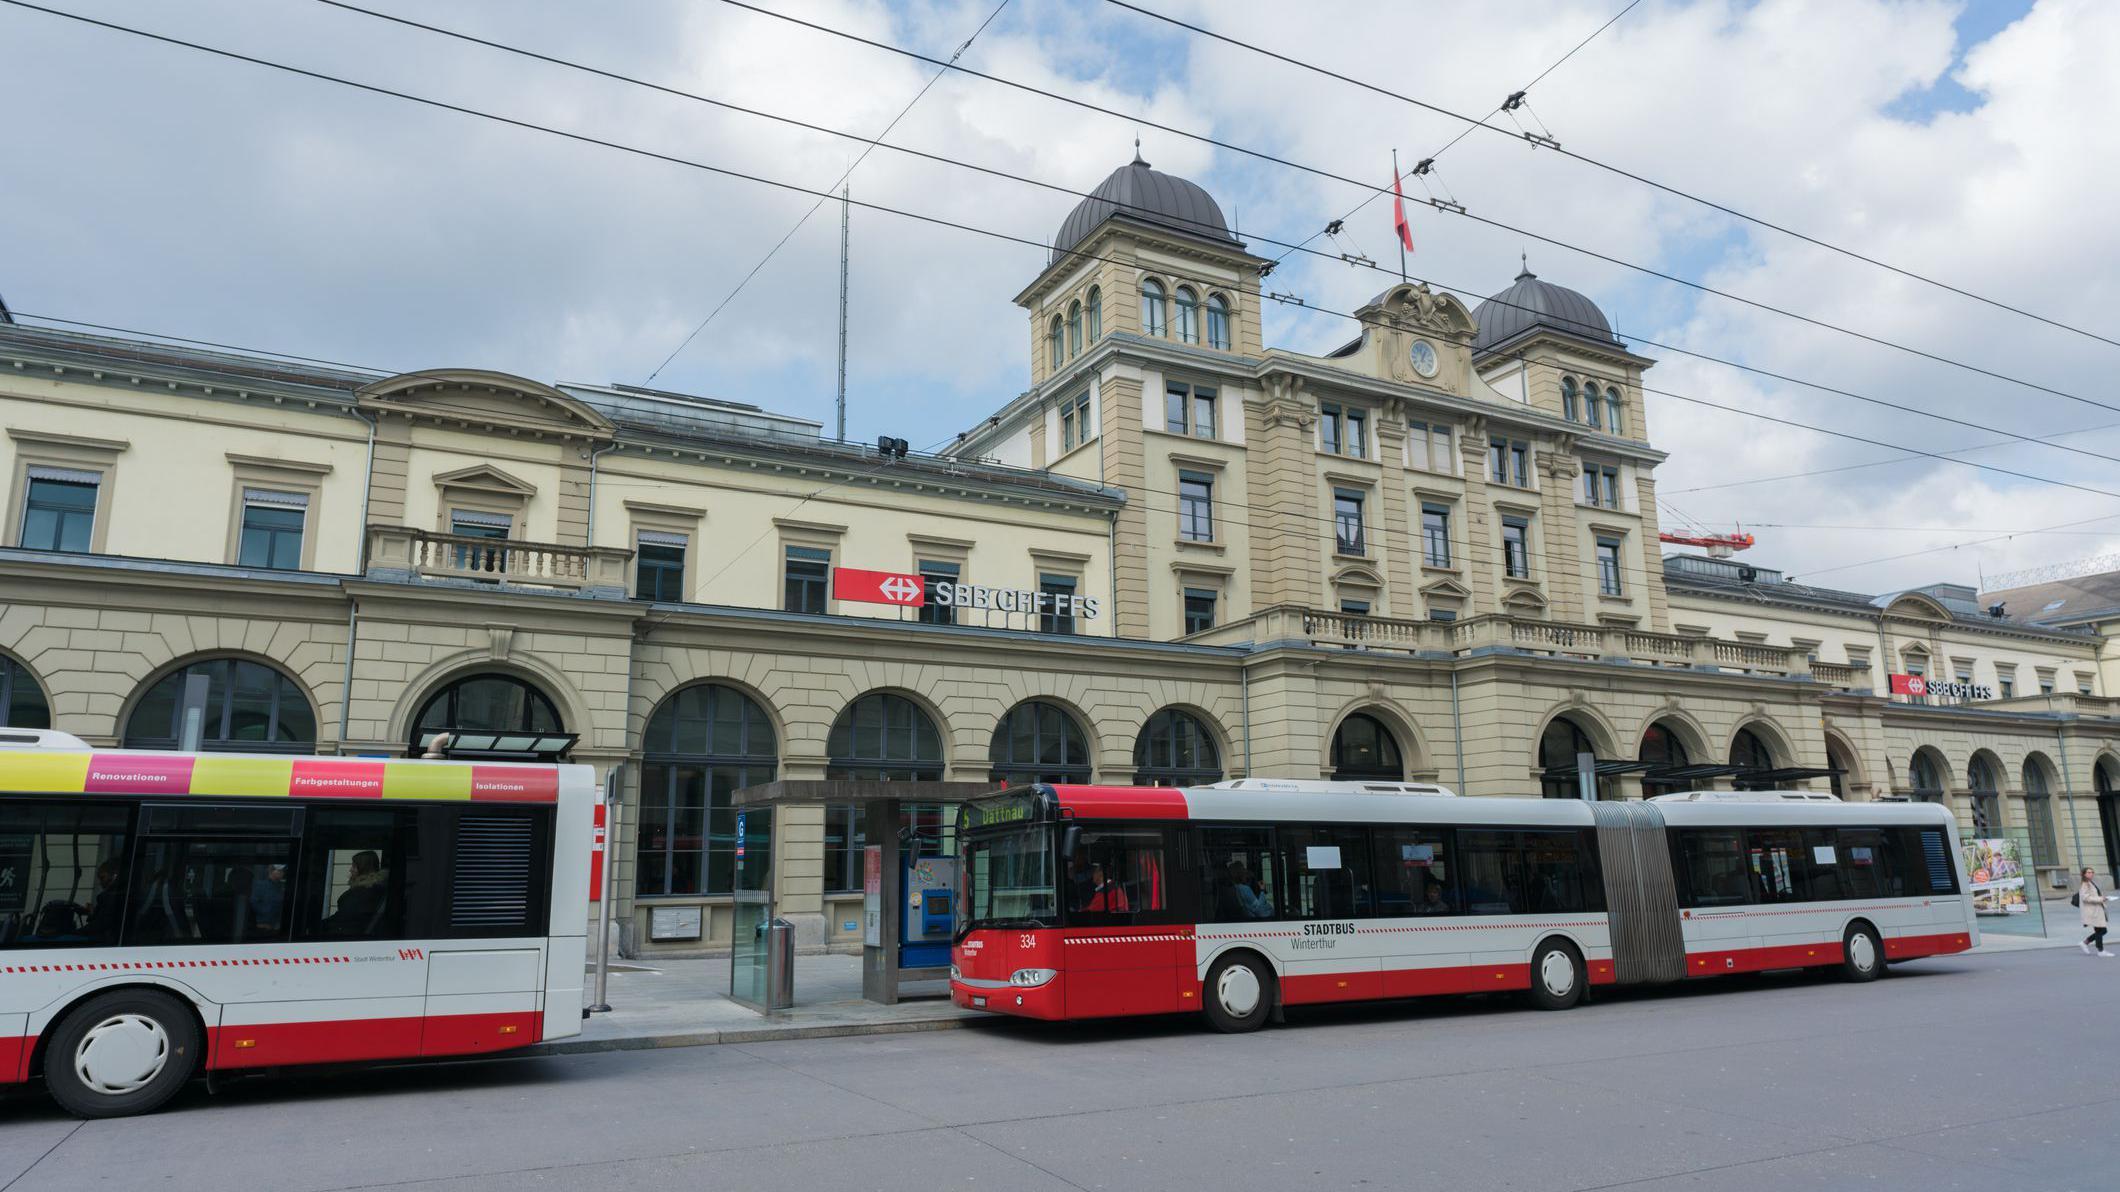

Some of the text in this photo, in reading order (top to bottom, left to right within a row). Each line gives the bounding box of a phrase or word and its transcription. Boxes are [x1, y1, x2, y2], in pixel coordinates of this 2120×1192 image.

[935, 581, 1100, 619] SBB CFF FFS
[1928, 680, 1993, 699] SBB CFF FFS
[92, 772, 167, 782] Renovationen
[295, 777, 379, 788] Farbgestaltungen
[476, 783, 524, 791] Isolationen
[738, 821, 744, 837] G
[1304, 922, 1355, 936] STADTBUS
[1020, 934, 1037, 949] 334
[1290, 938, 1337, 950] Winterthur
